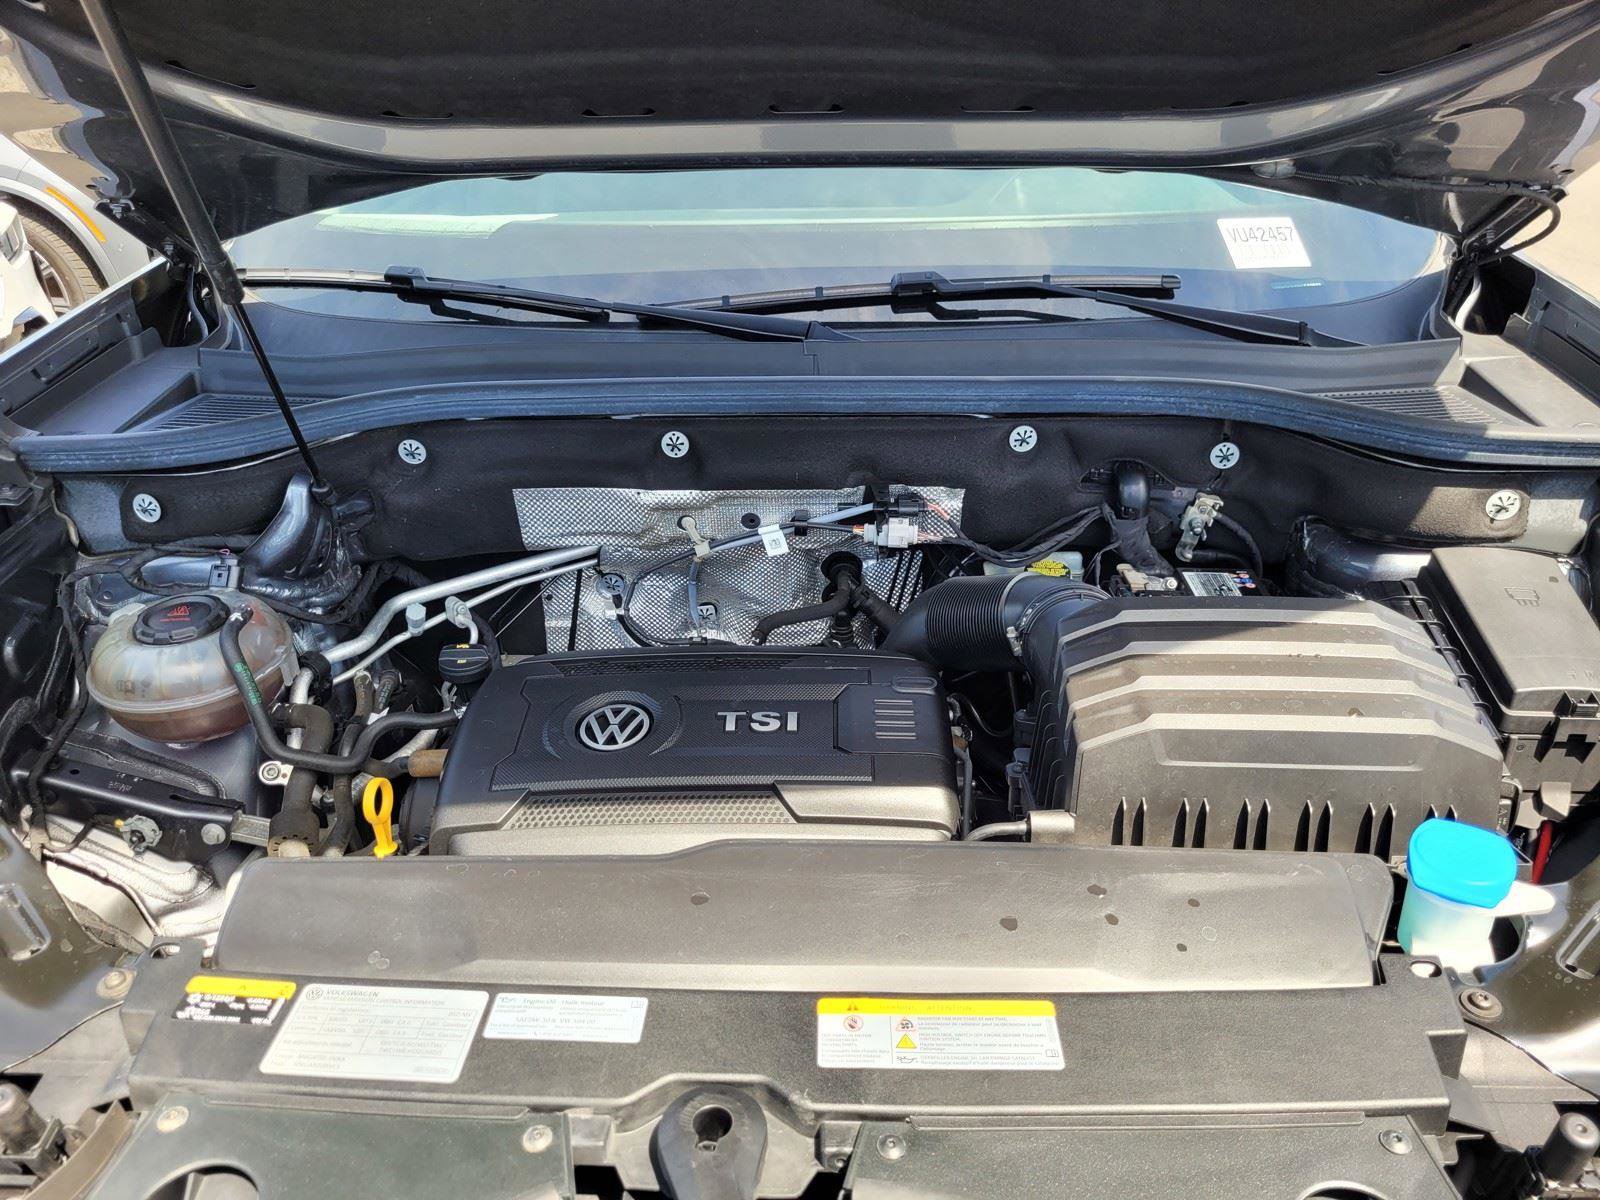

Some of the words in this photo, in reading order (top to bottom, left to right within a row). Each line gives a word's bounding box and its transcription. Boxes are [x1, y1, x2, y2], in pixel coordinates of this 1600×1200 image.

[1226, 226, 1293, 242] VU42457
[717, 711, 798, 732] TSI
[326, 988, 380, 998] VOLKSWAGEN
